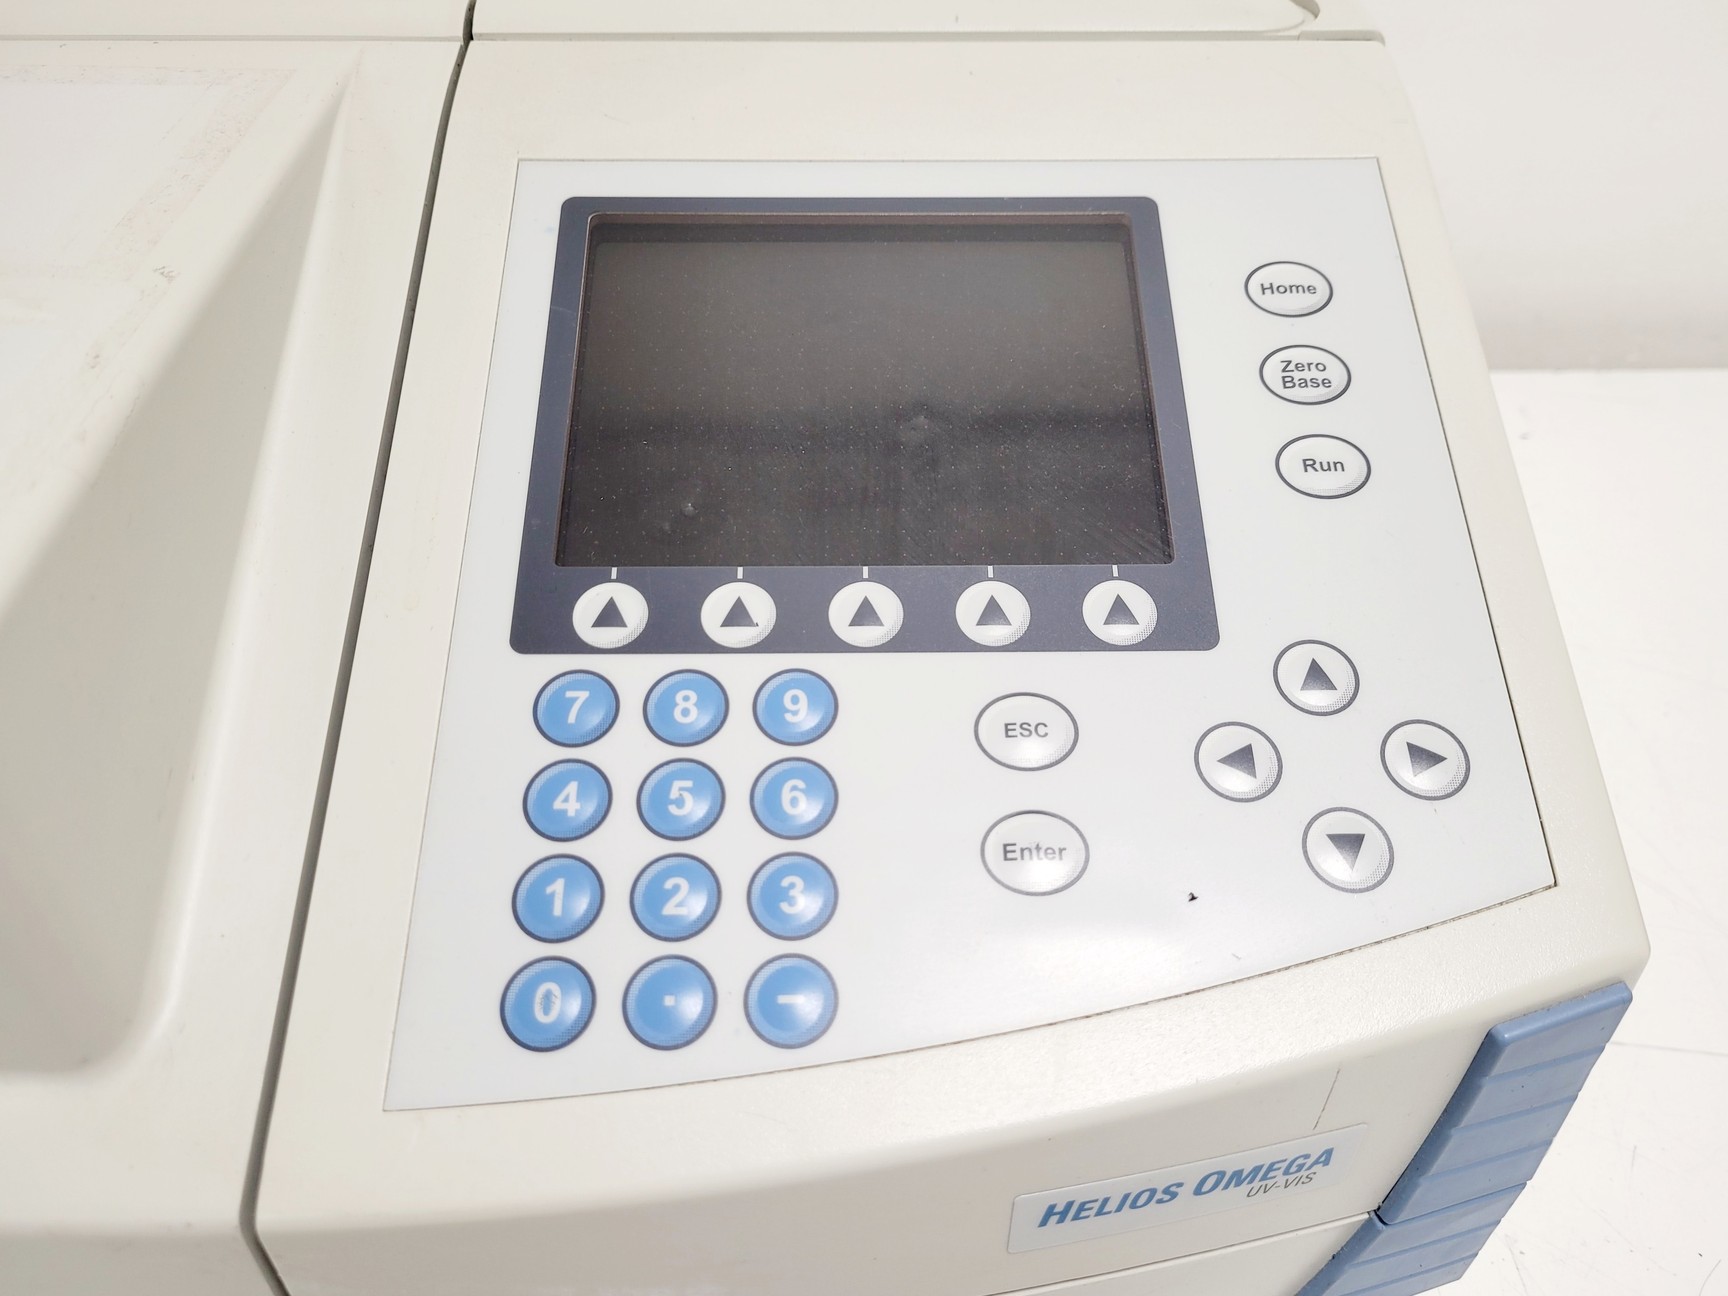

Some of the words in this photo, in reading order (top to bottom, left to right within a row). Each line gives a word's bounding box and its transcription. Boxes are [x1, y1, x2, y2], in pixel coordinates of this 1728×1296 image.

[1260, 282, 1317, 295] Home
[1280, 360, 1327, 373] Zero
[1281, 375, 1332, 389] Base
[1302, 458, 1345, 472] Run
[564, 690, 590, 724] 7
[673, 689, 699, 724] 8
[783, 688, 808, 723] 9
[1004, 722, 1049, 738] ESC
[552, 780, 581, 817] 4
[667, 780, 694, 816] 5
[781, 779, 806, 815] 6
[1002, 842, 1067, 862] Enter
[545, 878, 566, 917] 1
[661, 877, 690, 916] 2
[779, 876, 806, 914] 3
[533, 982, 562, 1024] 0
[1037, 1181, 1184, 1228] HELIOS
[1192, 1147, 1335, 1196] OMEGA
[1246, 1171, 1318, 1198] UV-VIS
